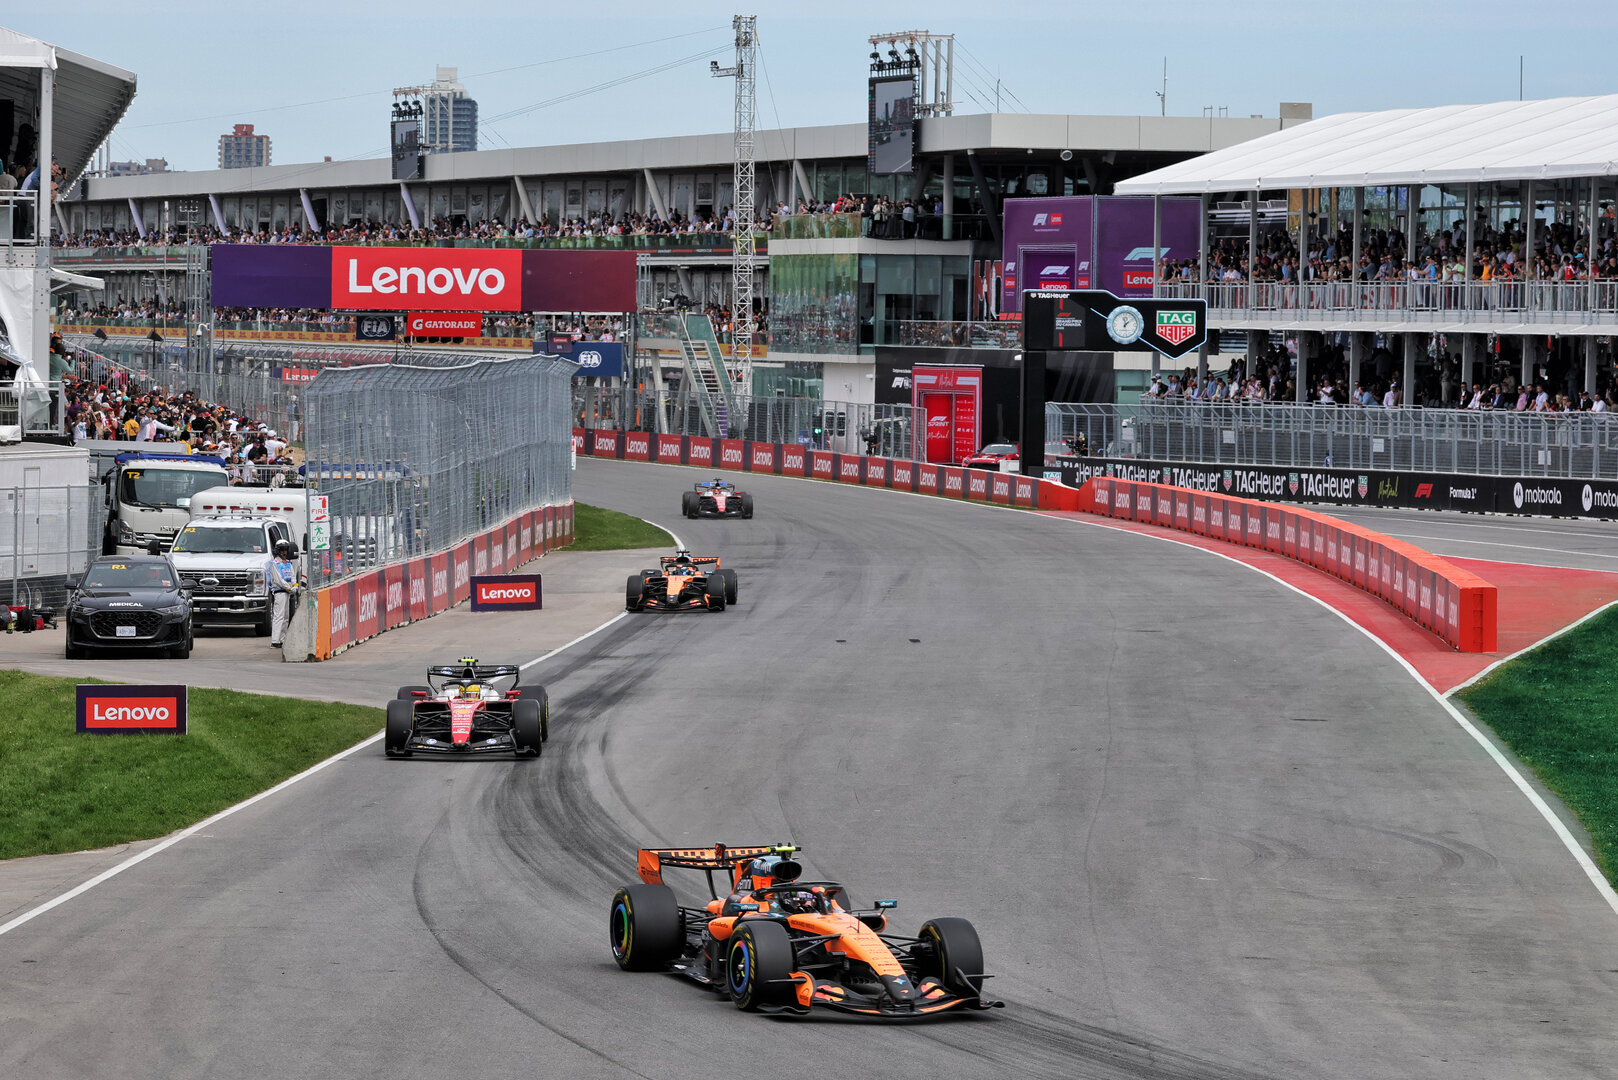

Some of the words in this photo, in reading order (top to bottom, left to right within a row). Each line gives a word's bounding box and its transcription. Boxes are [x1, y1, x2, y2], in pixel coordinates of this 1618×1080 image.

[349, 259, 505, 295] Lenovo
[424, 321, 476, 329] GATORADE
[1160, 313, 1193, 324] TAG
[1159, 326, 1194, 343] HEUER
[595, 435, 615, 451] Lenovo
[627, 437, 648, 454] Lenovo
[660, 440, 680, 457] Lenovo
[691, 441, 711, 459] Lenovo
[722, 445, 742, 463] Lenovo
[753, 448, 772, 466] Lenovo
[784, 451, 803, 469] Lenovo
[814, 455, 831, 473] Lenovo
[841, 459, 859, 477] Lenovo
[868, 462, 884, 479] Lenovo
[894, 465, 910, 483] Lenovo
[920, 468, 936, 487] Lenovo
[945, 472, 961, 490] Lenovo
[970, 475, 985, 493] Lenovo
[994, 478, 1008, 496] Lenovo
[1016, 480, 1031, 498] Lenovo
[1449, 486, 1471, 499] Formula
[1525, 486, 1562, 504] motorola
[432, 567, 447, 597] Lenovo
[454, 559, 469, 589] Lenovo
[386, 580, 402, 612] Lenovo
[409, 574, 425, 605] Lenovo
[481, 588, 532, 600] Lenovo
[358, 589, 377, 623] Lenovo
[331, 602, 348, 634] Lenovo
[94, 704, 169, 720] Lenovo
